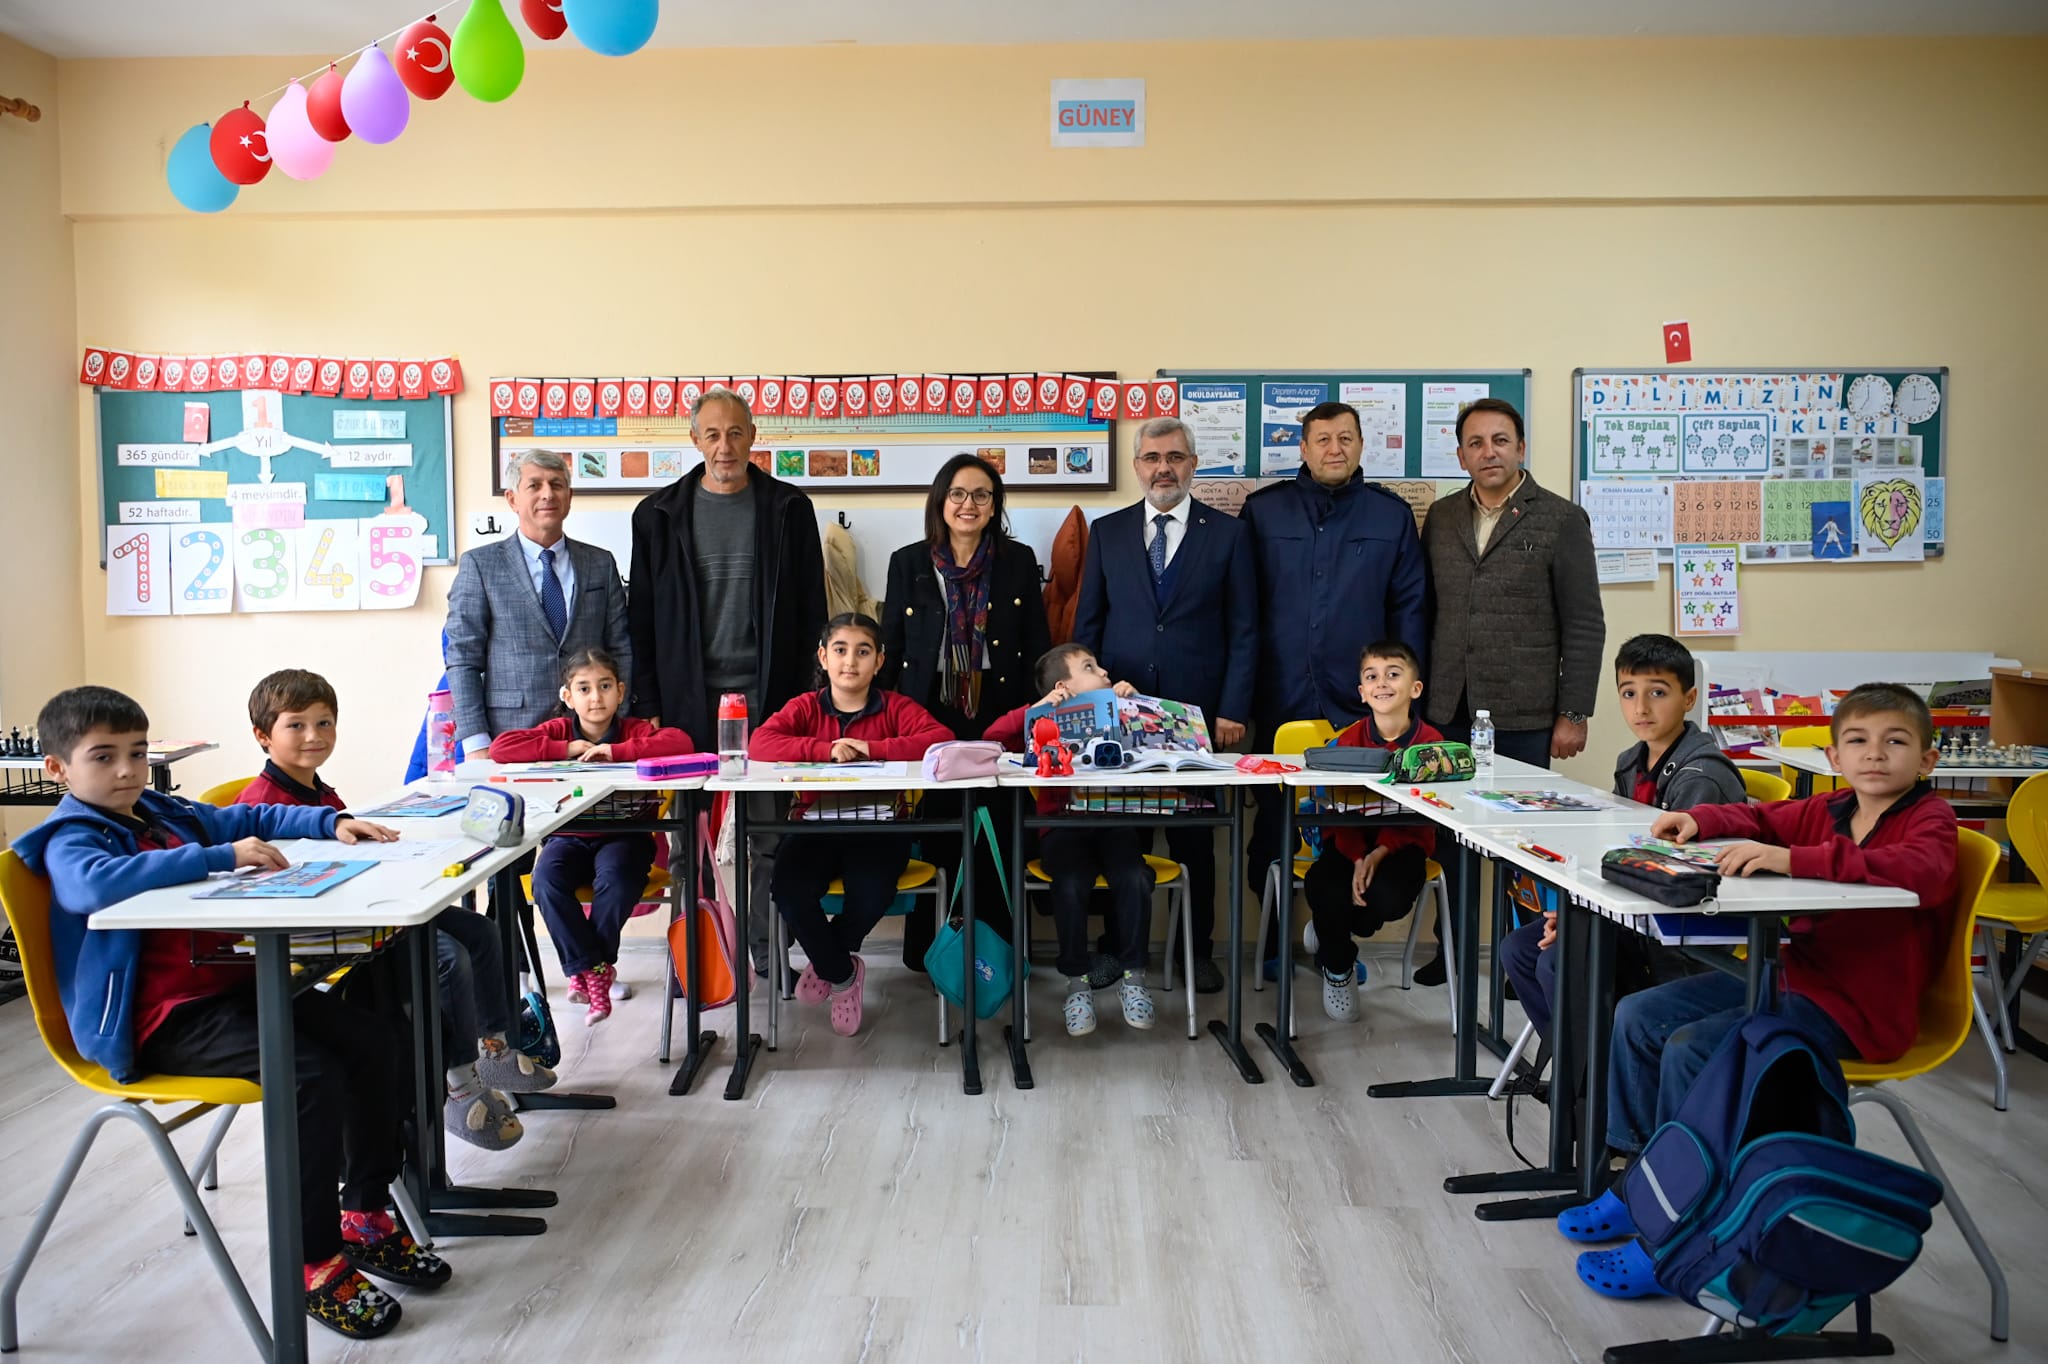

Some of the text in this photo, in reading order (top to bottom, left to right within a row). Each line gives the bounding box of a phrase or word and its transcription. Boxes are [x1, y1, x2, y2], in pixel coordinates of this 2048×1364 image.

[1059, 104, 1134, 127] GÜNEY
[1187, 391, 1240, 399] OKULDAYSANIZ
[1271, 387, 1320, 396] Deprem Anında
[255, 435, 272, 449] Yıl
[125, 450, 193, 462] 365 gündür.
[348, 450, 395, 465] 12 aydır.
[231, 489, 302, 501] 4 mevsimdir.
[1679, 500, 1758, 511] 3 6 9 12 15
[1768, 501, 1811, 510] 4 8 12
[1927, 497, 1940, 508] 25
[128, 506, 193, 518] 52 haftadır.
[1607, 530, 1614, 538] C
[1623, 530, 1631, 538] D
[1639, 530, 1647, 538] M
[1677, 532, 1760, 542] 18 21 24 27 30
[1766, 533, 1779, 542] 24
[1784, 533, 1797, 542] 28
[1927, 530, 1940, 539] 50
[370, 527, 417, 596] 5
